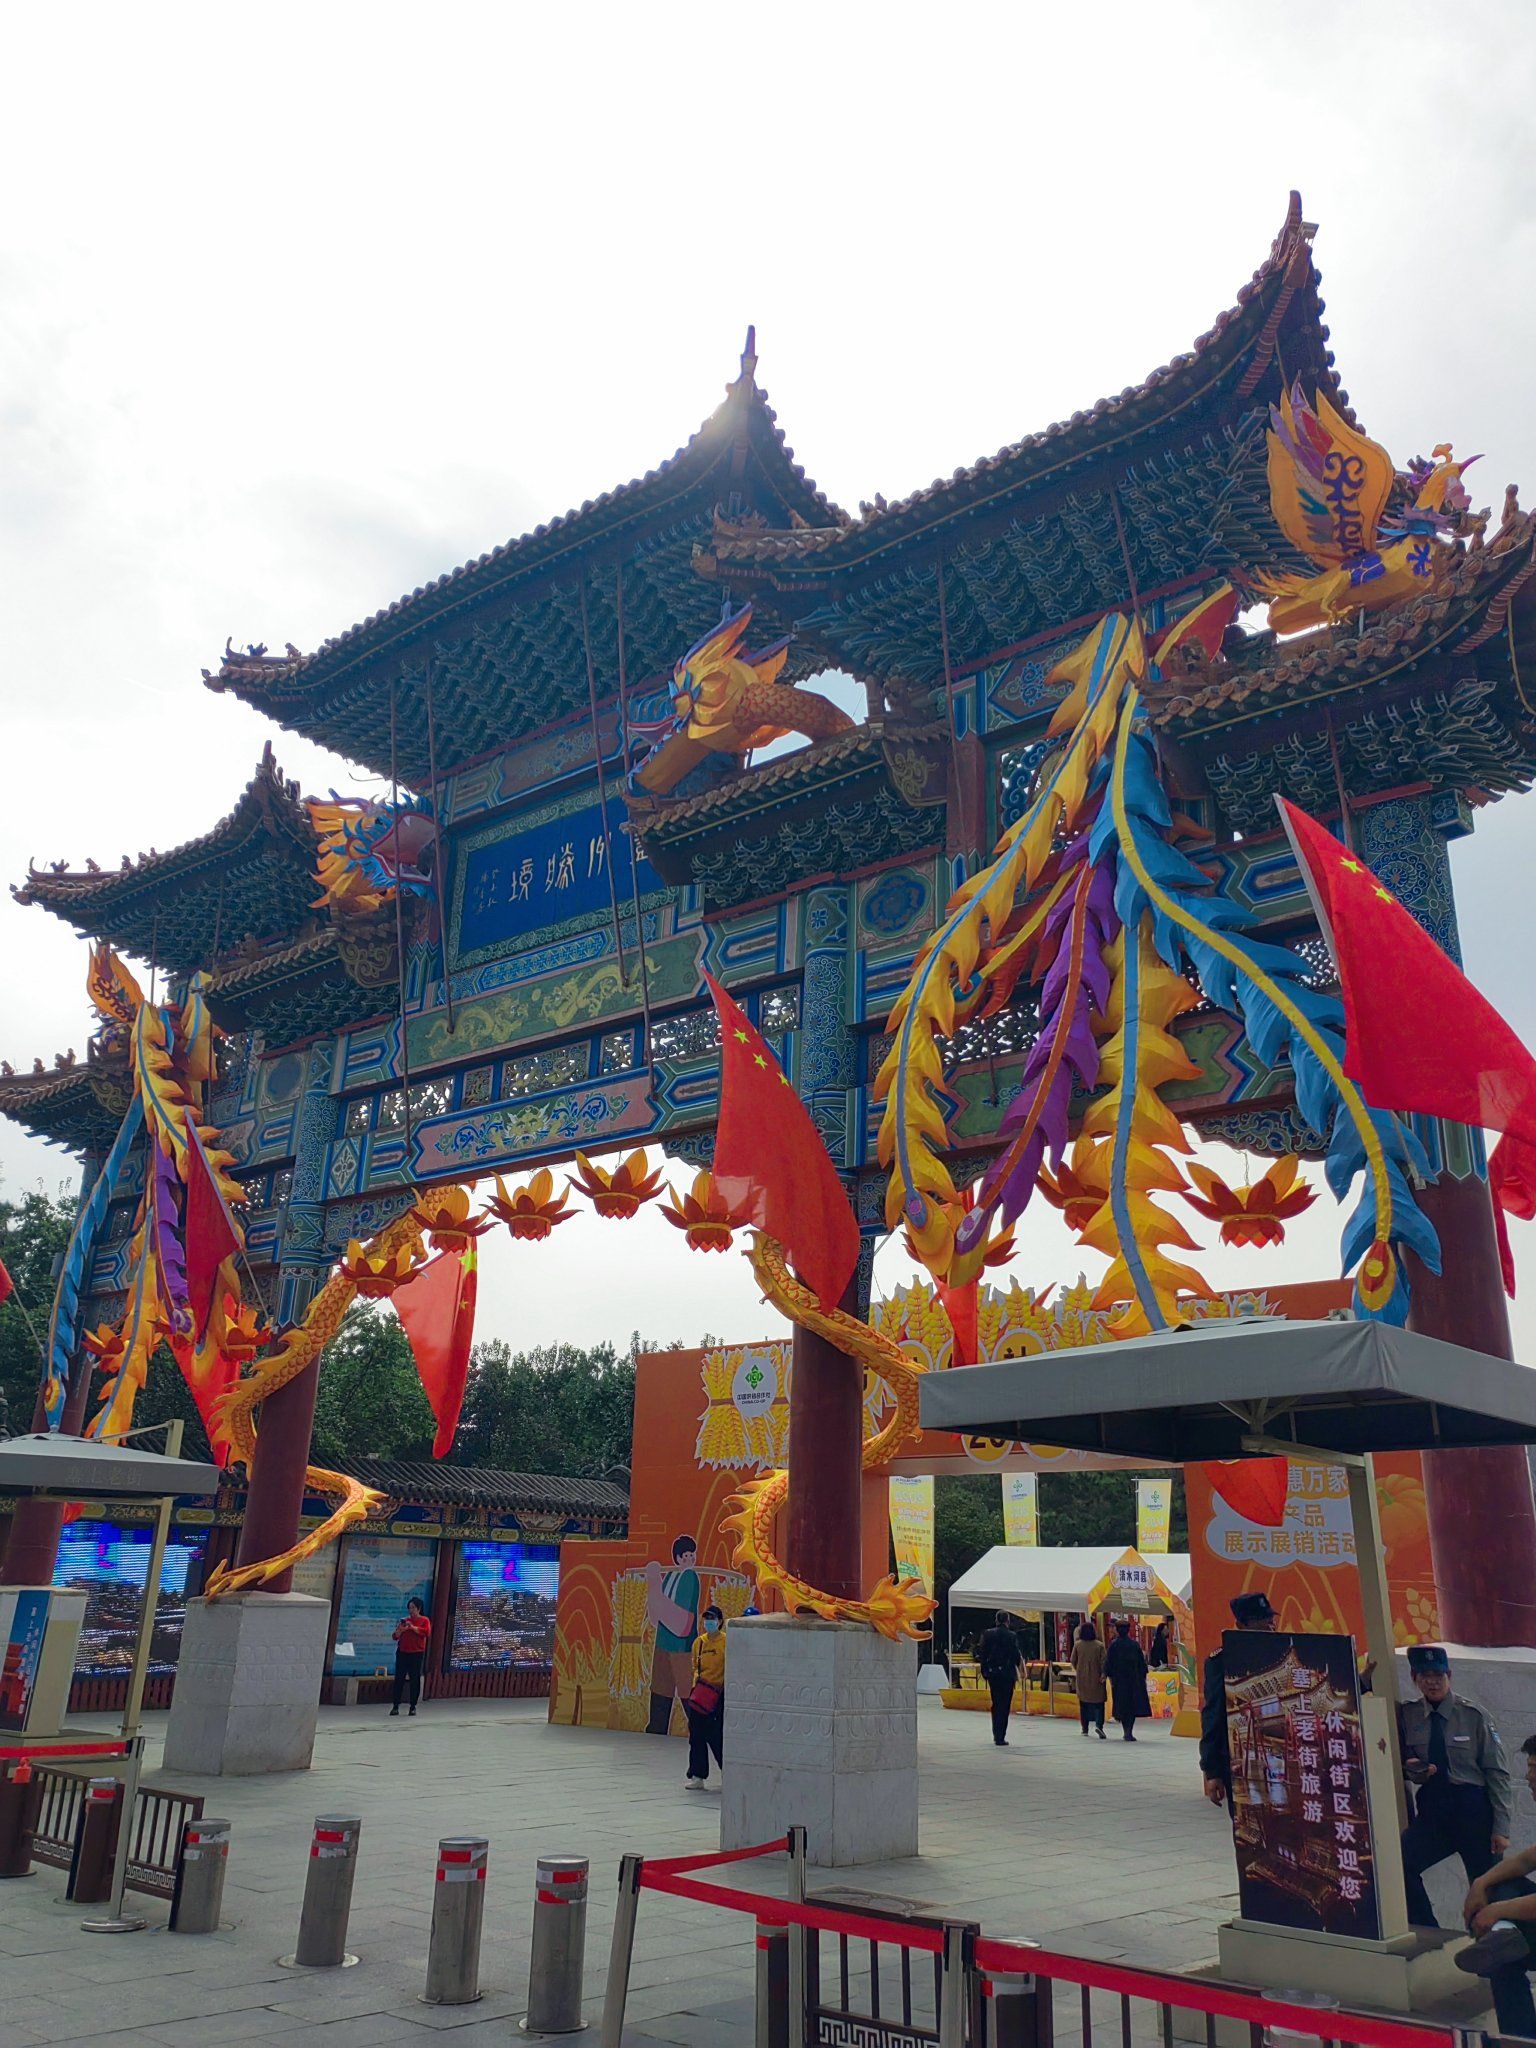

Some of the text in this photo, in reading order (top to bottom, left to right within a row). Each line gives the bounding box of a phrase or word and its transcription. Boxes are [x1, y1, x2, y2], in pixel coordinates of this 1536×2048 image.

[1119, 1569, 1147, 1583] 清水河县
[1291, 1668, 1324, 1824] 塞上老街旅游
[1325, 1711, 1363, 1900] 休闲街区欢迎您
